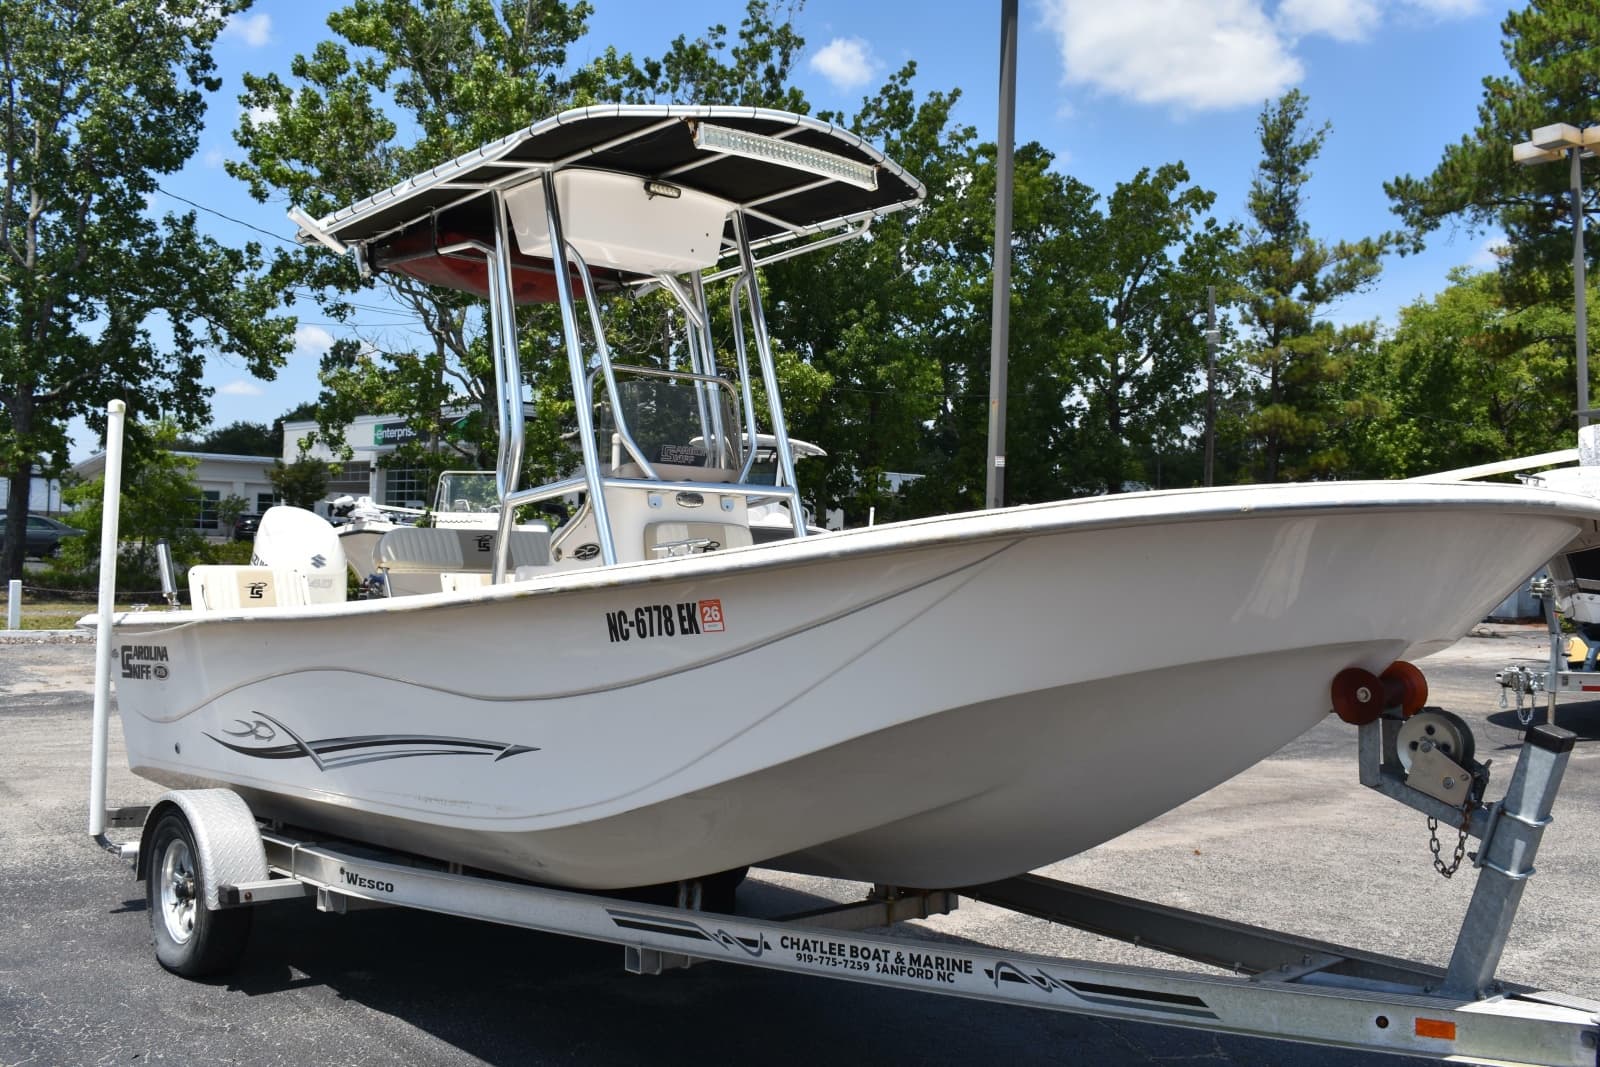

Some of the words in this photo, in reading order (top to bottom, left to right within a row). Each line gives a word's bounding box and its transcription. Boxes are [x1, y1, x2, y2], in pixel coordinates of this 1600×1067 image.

[605, 604, 676, 643] NC-6778
[676, 602, 701, 636] EK
[702, 605, 721, 622] 26
[121, 645, 169, 662] CAROLINA
[121, 663, 152, 680] SKIFF
[345, 871, 395, 893] WESCO
[780, 935, 846, 957] CHATLEE
[849, 944, 891, 963] BOAT
[894, 951, 905, 966] &
[908, 952, 973, 974] MARINE
[795, 952, 870, 971] 919-775-7259
[876, 962, 934, 980] SANFORD
[936, 970, 955, 983] NC
